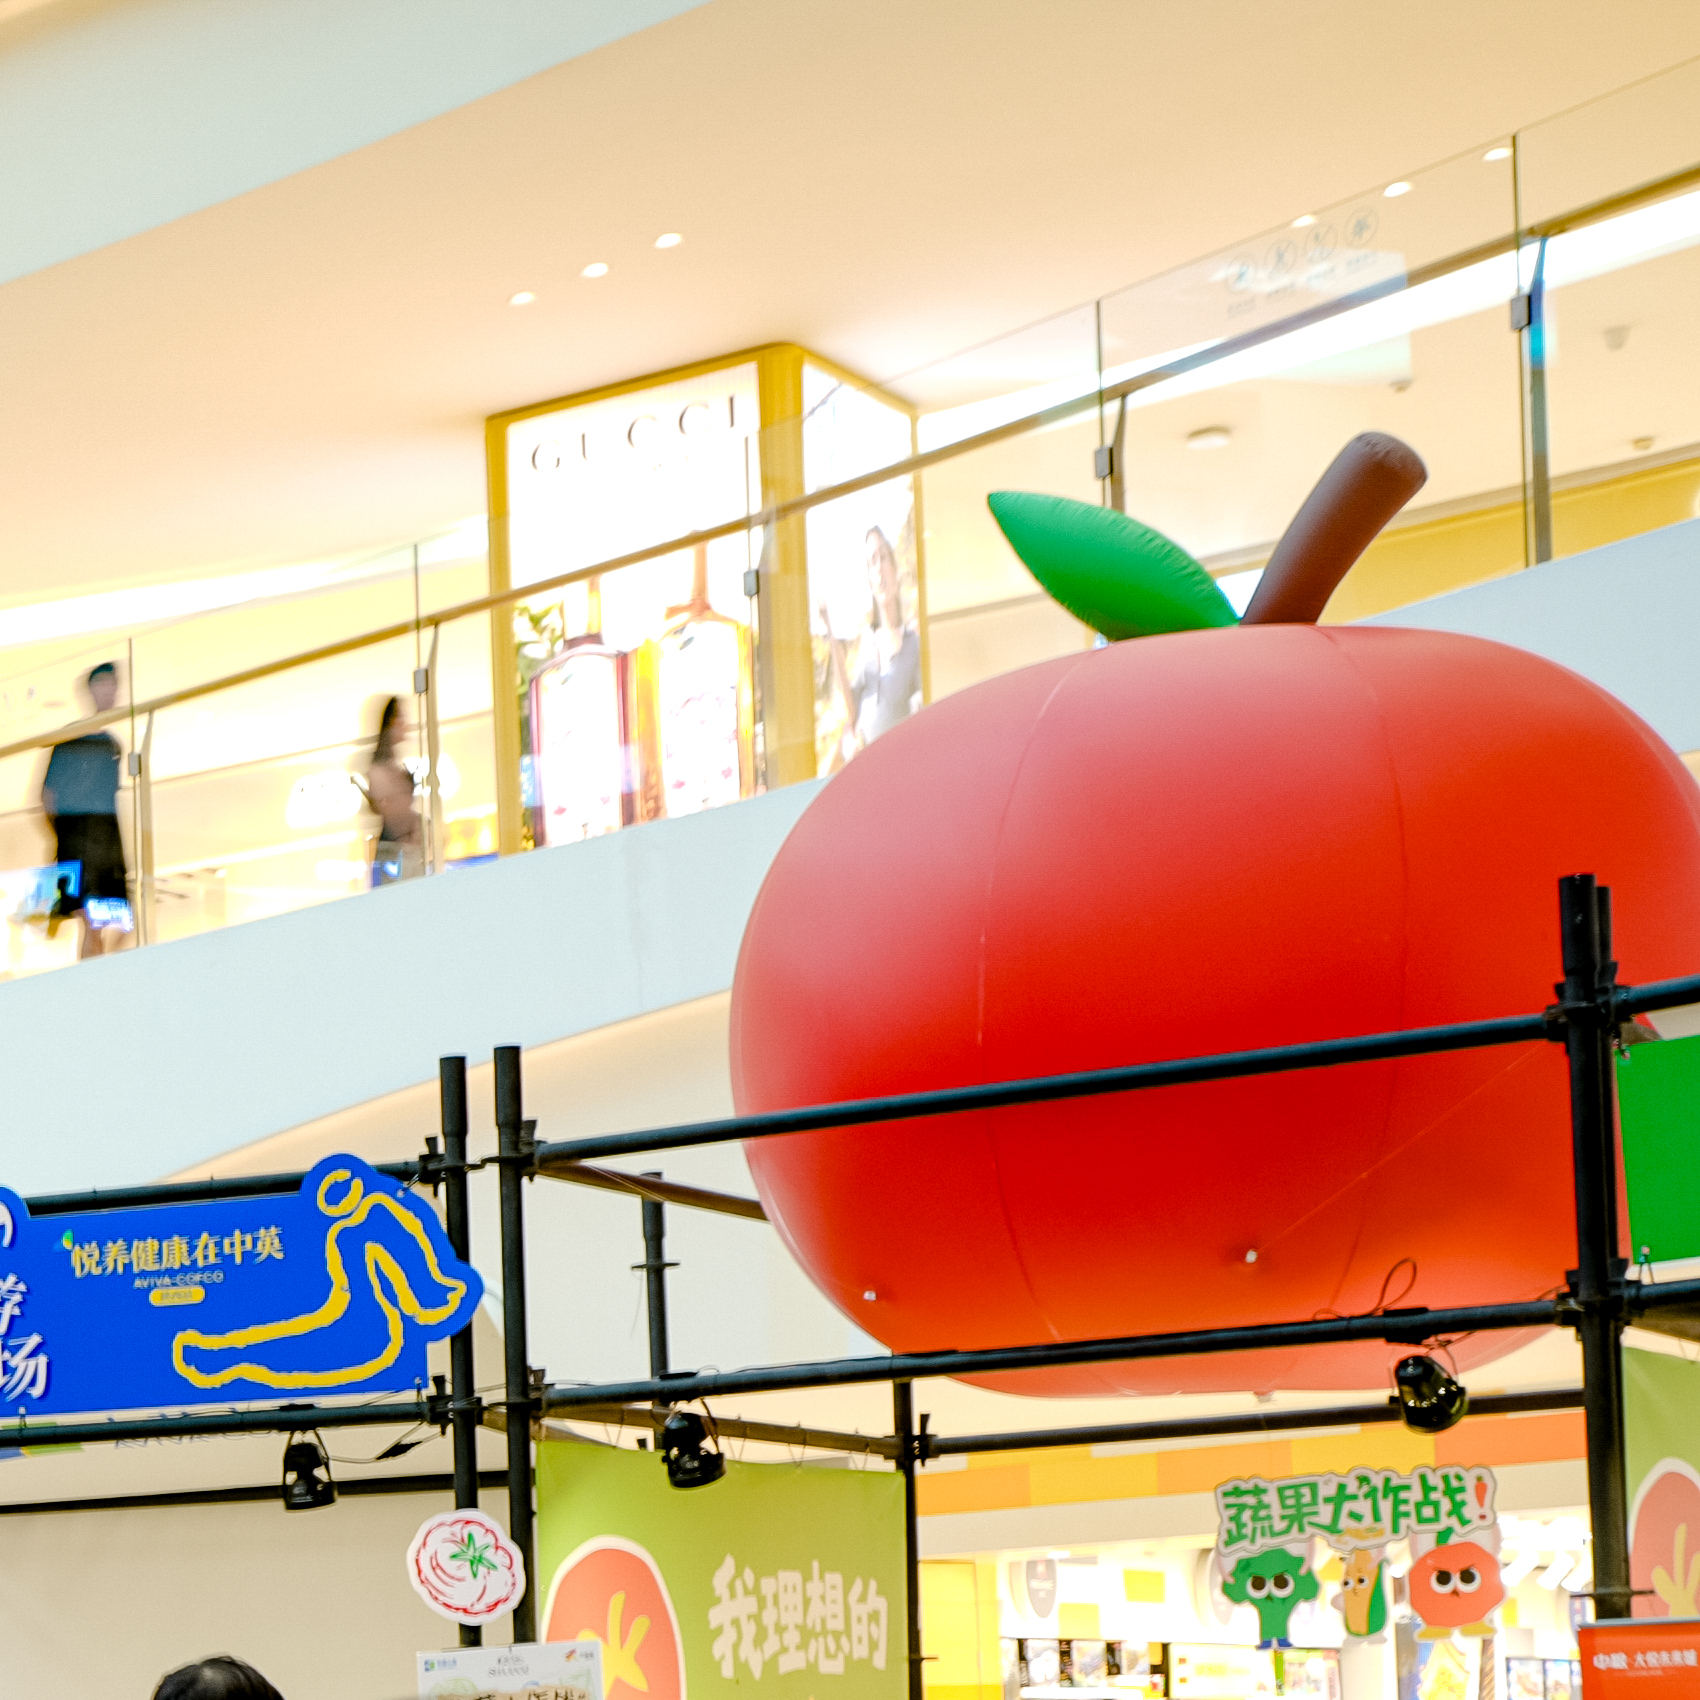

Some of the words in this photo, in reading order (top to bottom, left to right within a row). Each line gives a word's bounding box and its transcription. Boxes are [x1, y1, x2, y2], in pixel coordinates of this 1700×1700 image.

[71, 1225, 285, 1279] 悦养健康在中英
[708, 1552, 888, 1681] 我理想的
